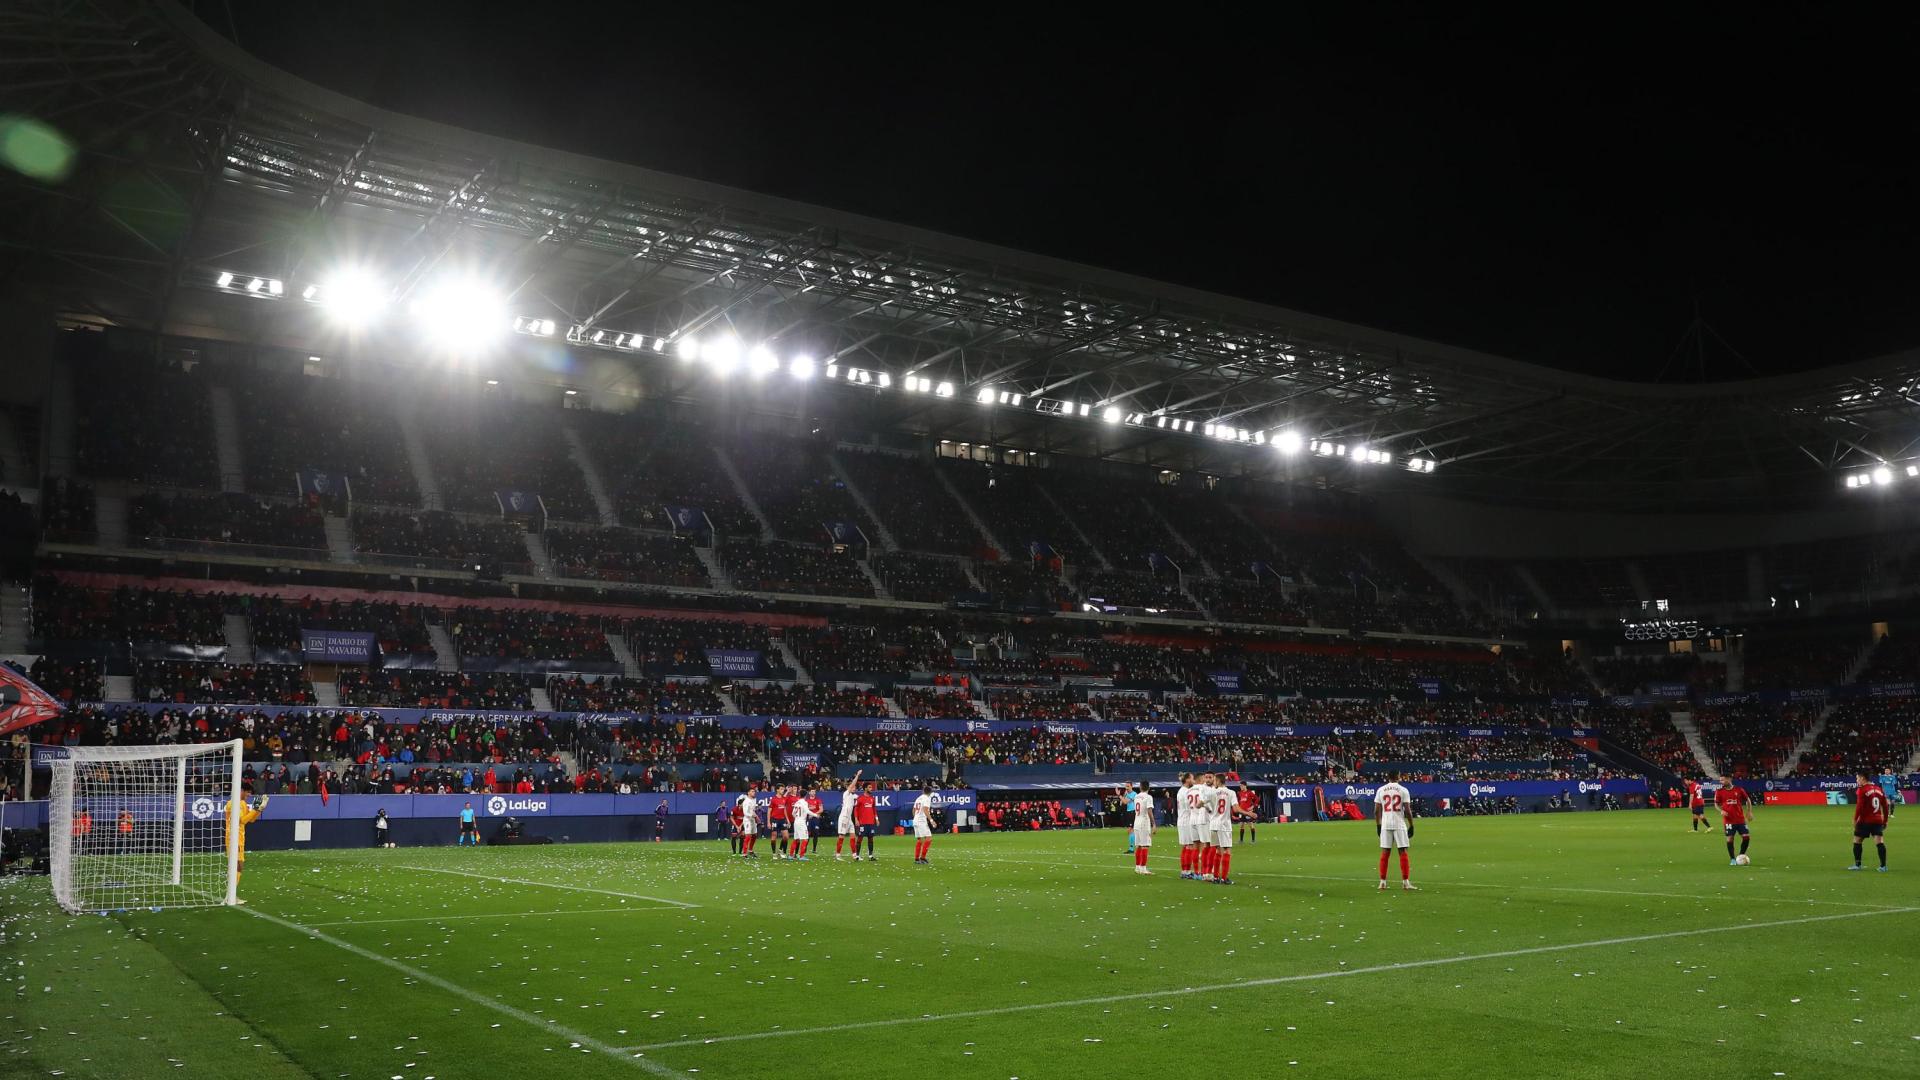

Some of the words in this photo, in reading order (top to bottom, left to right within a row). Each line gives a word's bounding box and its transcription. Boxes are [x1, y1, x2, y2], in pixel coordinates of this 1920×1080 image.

[328, 638, 355, 646] DIARIO
[328, 647, 368, 655] NAVARRA
[1479, 785, 1496, 794] LaLiga
[1586, 782, 1602, 791] LaLiga
[1286, 789, 1307, 798] SELK
[1355, 787, 1375, 796] LaLiga
[943, 794, 970, 805] LaLiga
[1383, 795, 1402, 812] 22
[509, 799, 546, 812] LaLiga
[1218, 798, 1226, 814] 8
[1872, 797, 1879, 813] 9
